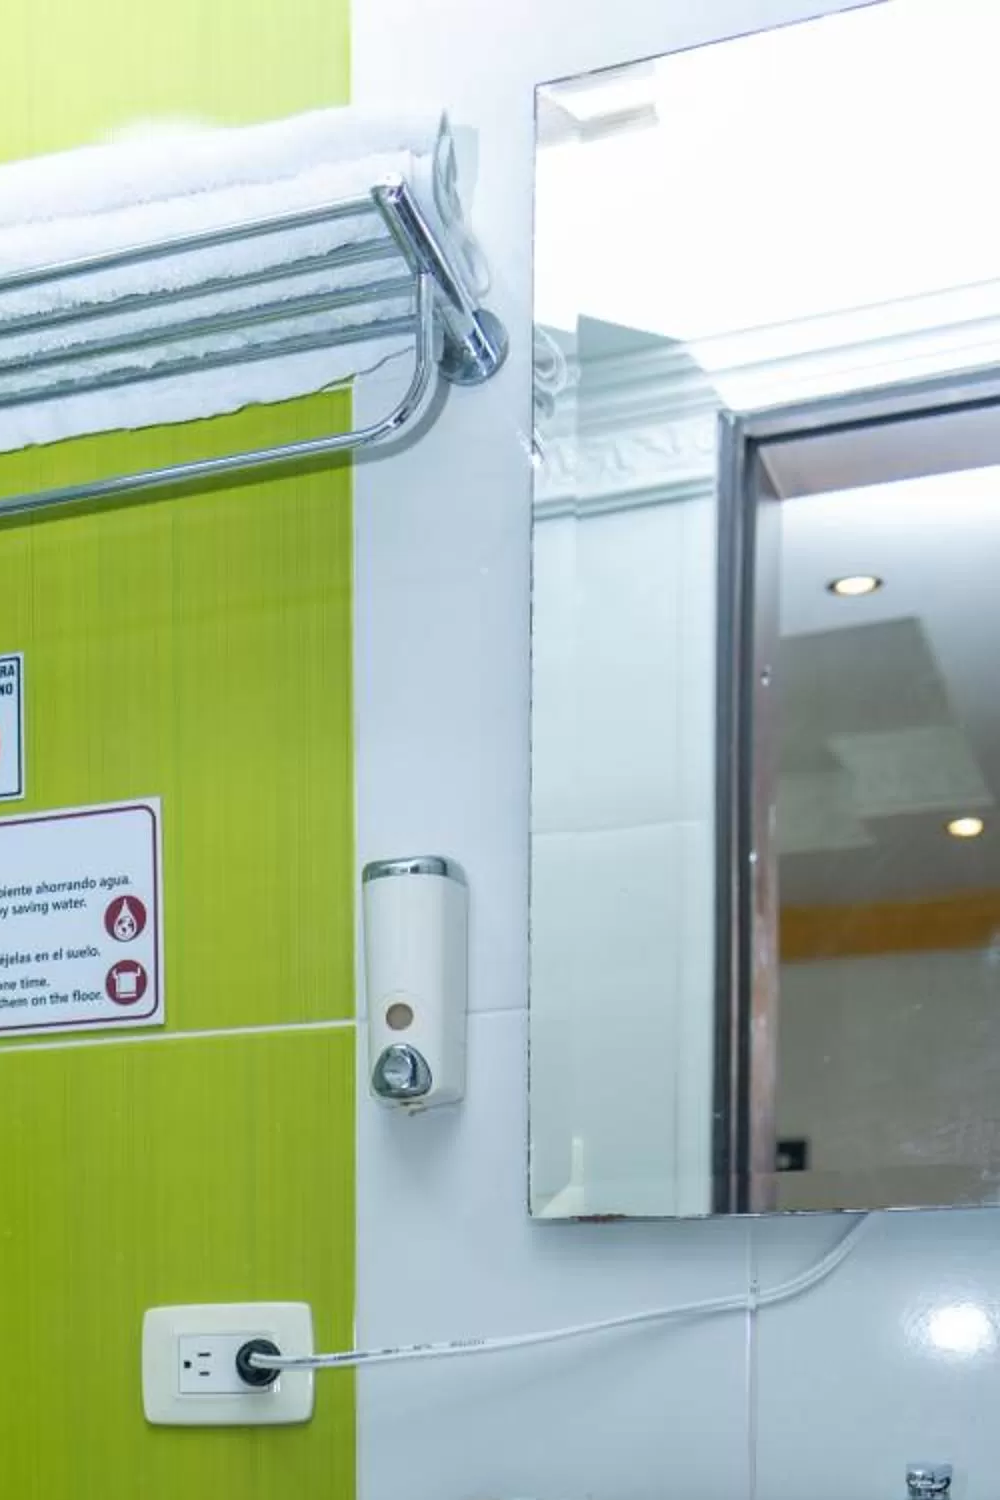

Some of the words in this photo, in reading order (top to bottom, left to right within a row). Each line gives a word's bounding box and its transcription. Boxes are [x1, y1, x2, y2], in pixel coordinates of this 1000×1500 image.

[35, 876, 97, 894] ahorrando
[99, 875, 131, 891] agua.
[12, 900, 49, 915] saving
[52, 898, 87, 911] water.
[35, 951, 49, 963] en
[52, 948, 63, 960] el
[20, 977, 51, 989] time.
[31, 997, 46, 1007] on
[49, 993, 69, 1004] the
